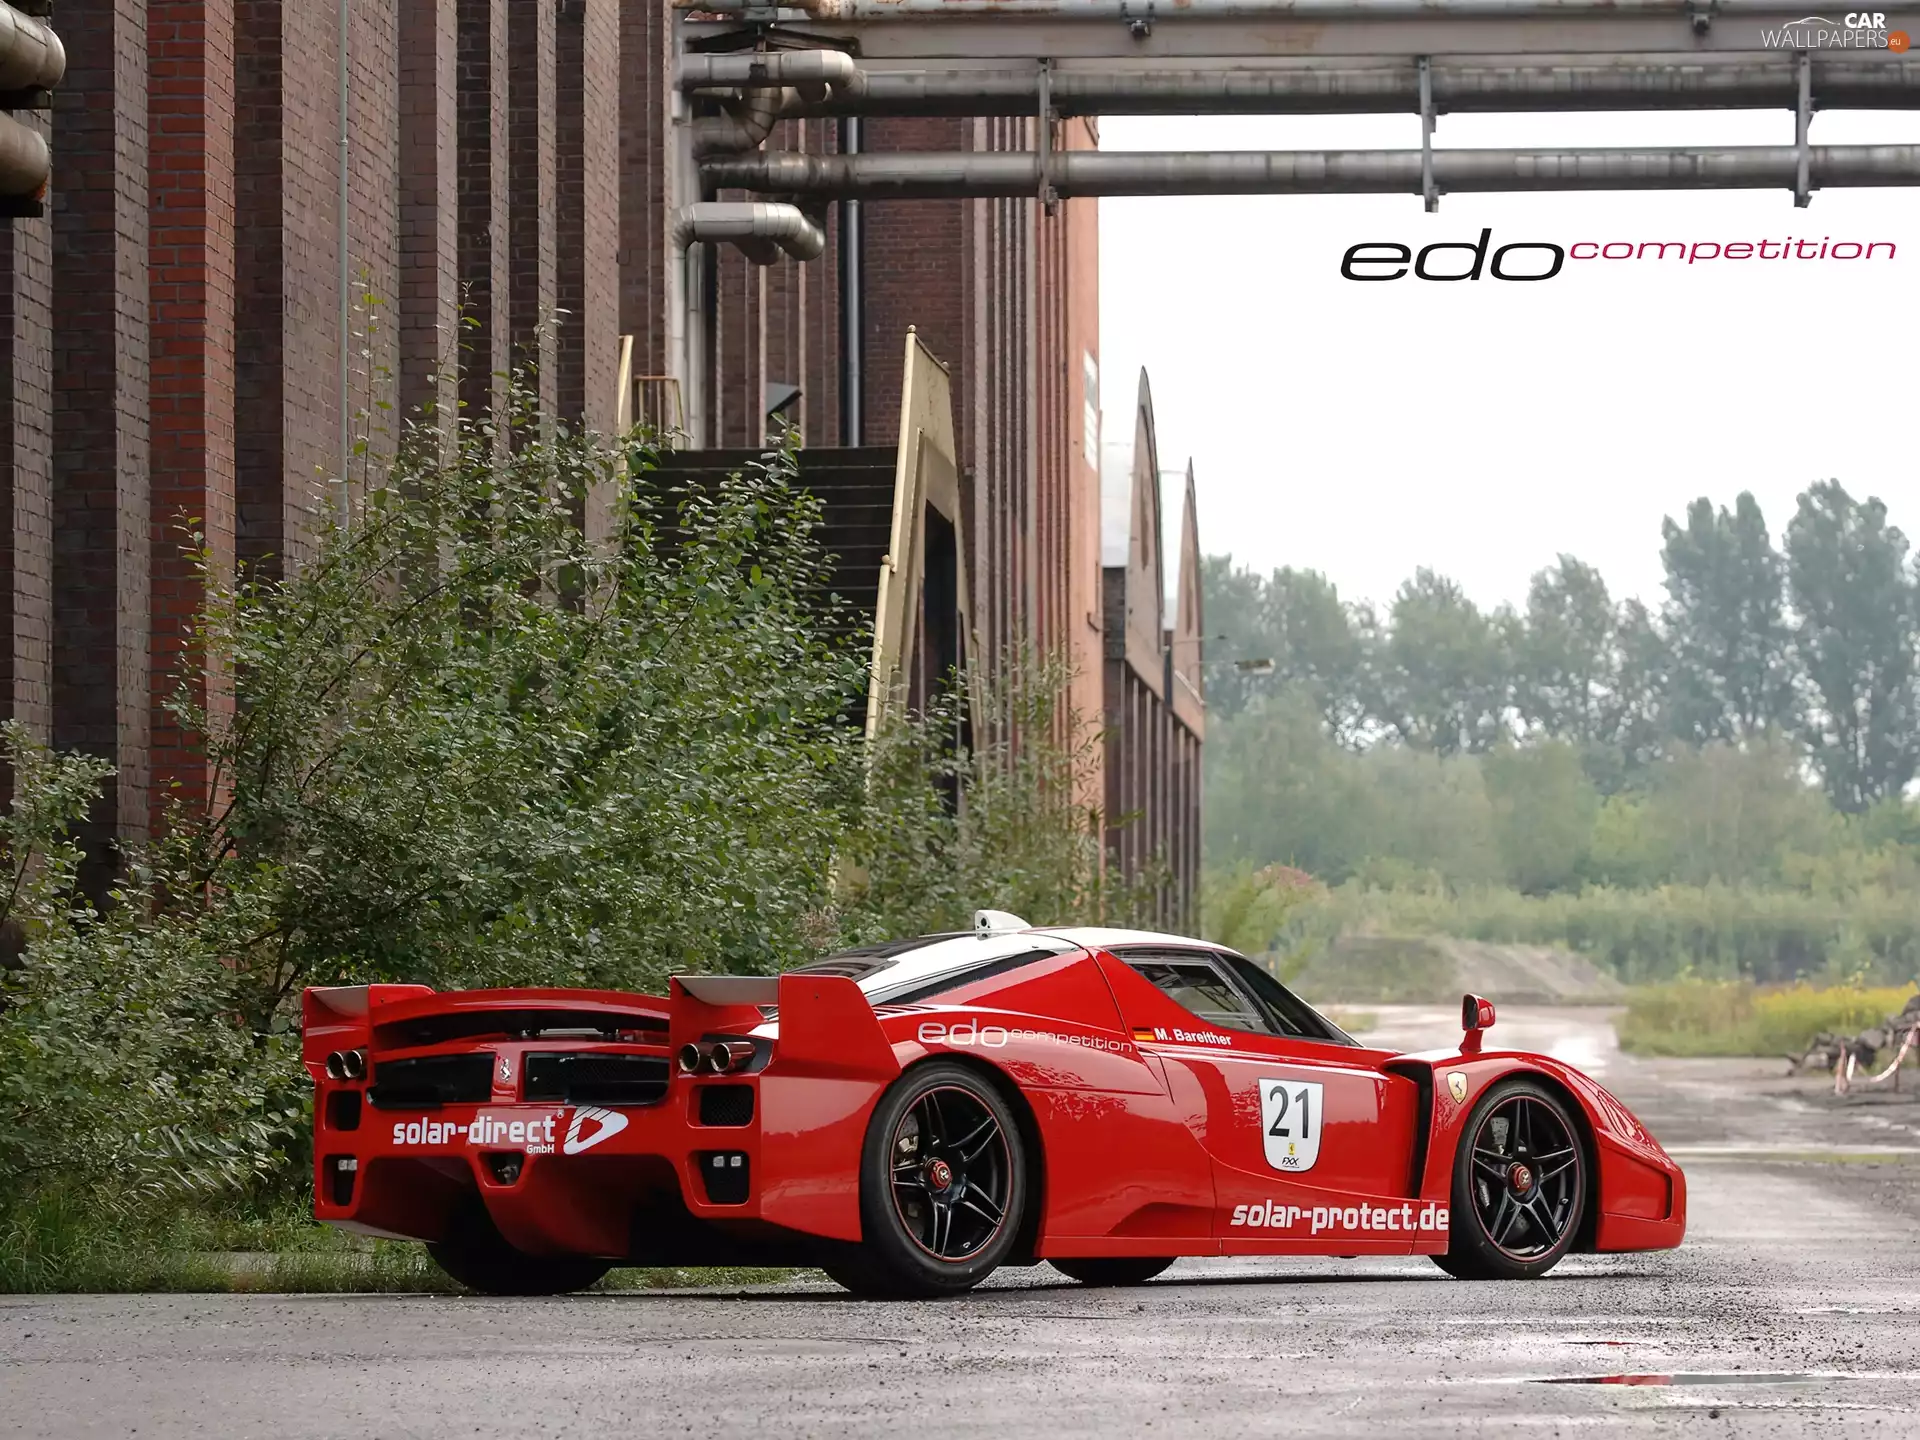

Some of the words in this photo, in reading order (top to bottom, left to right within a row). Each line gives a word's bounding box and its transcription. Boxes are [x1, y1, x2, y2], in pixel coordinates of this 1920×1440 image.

[1010, 1028, 1132, 1053] competition
[1153, 1027, 1173, 1041] M.
[1174, 1028, 1233, 1046] Bareither
[1268, 1085, 1310, 1139] 21
[526, 1143, 555, 1155] GmbH
[1230, 1199, 1448, 1235] solar-protect.de
